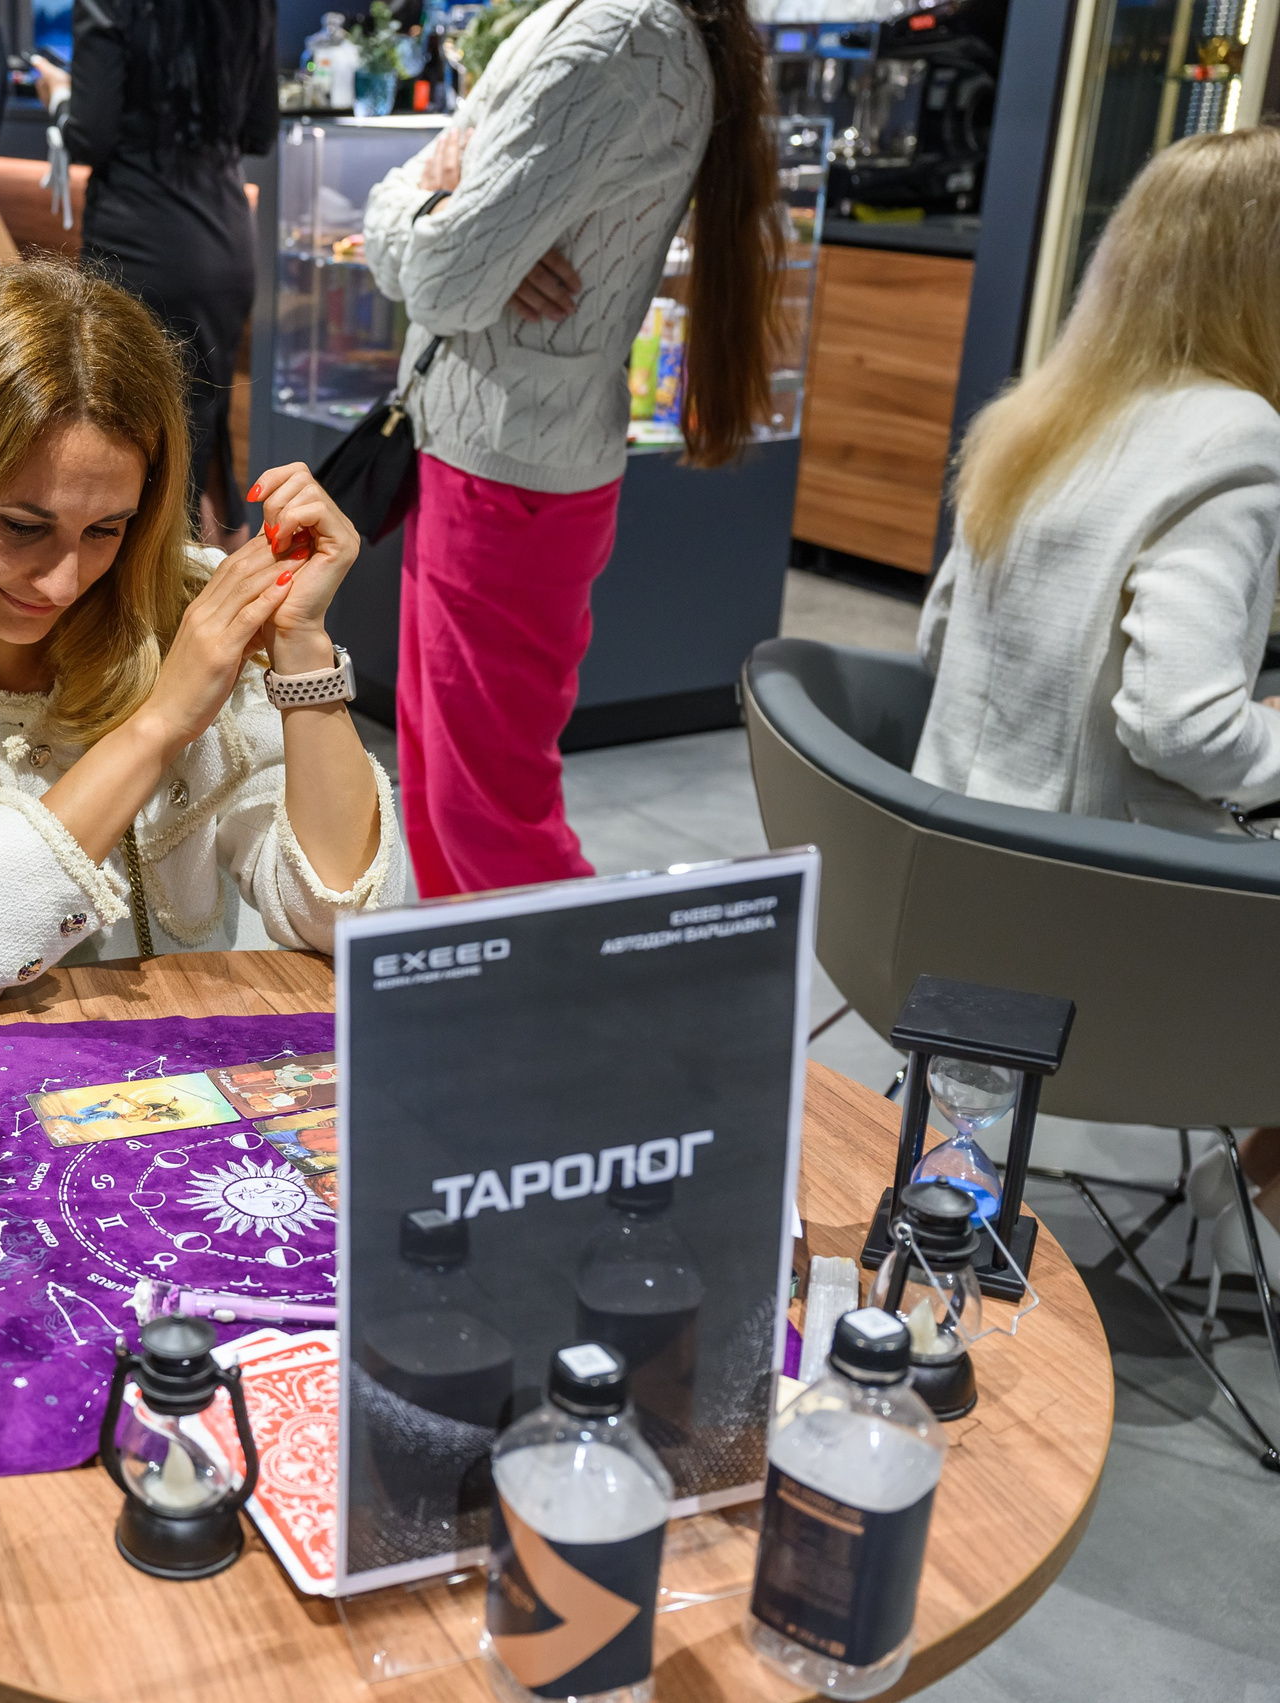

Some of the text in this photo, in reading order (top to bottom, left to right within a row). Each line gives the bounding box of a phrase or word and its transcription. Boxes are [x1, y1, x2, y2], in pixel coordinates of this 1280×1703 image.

[373, 938, 511, 977] EXEED
[27, 1162, 51, 1191] CANCER
[432, 1130, 714, 1220] ТАРОЛОГ
[87, 1273, 135, 1295] AURUS
